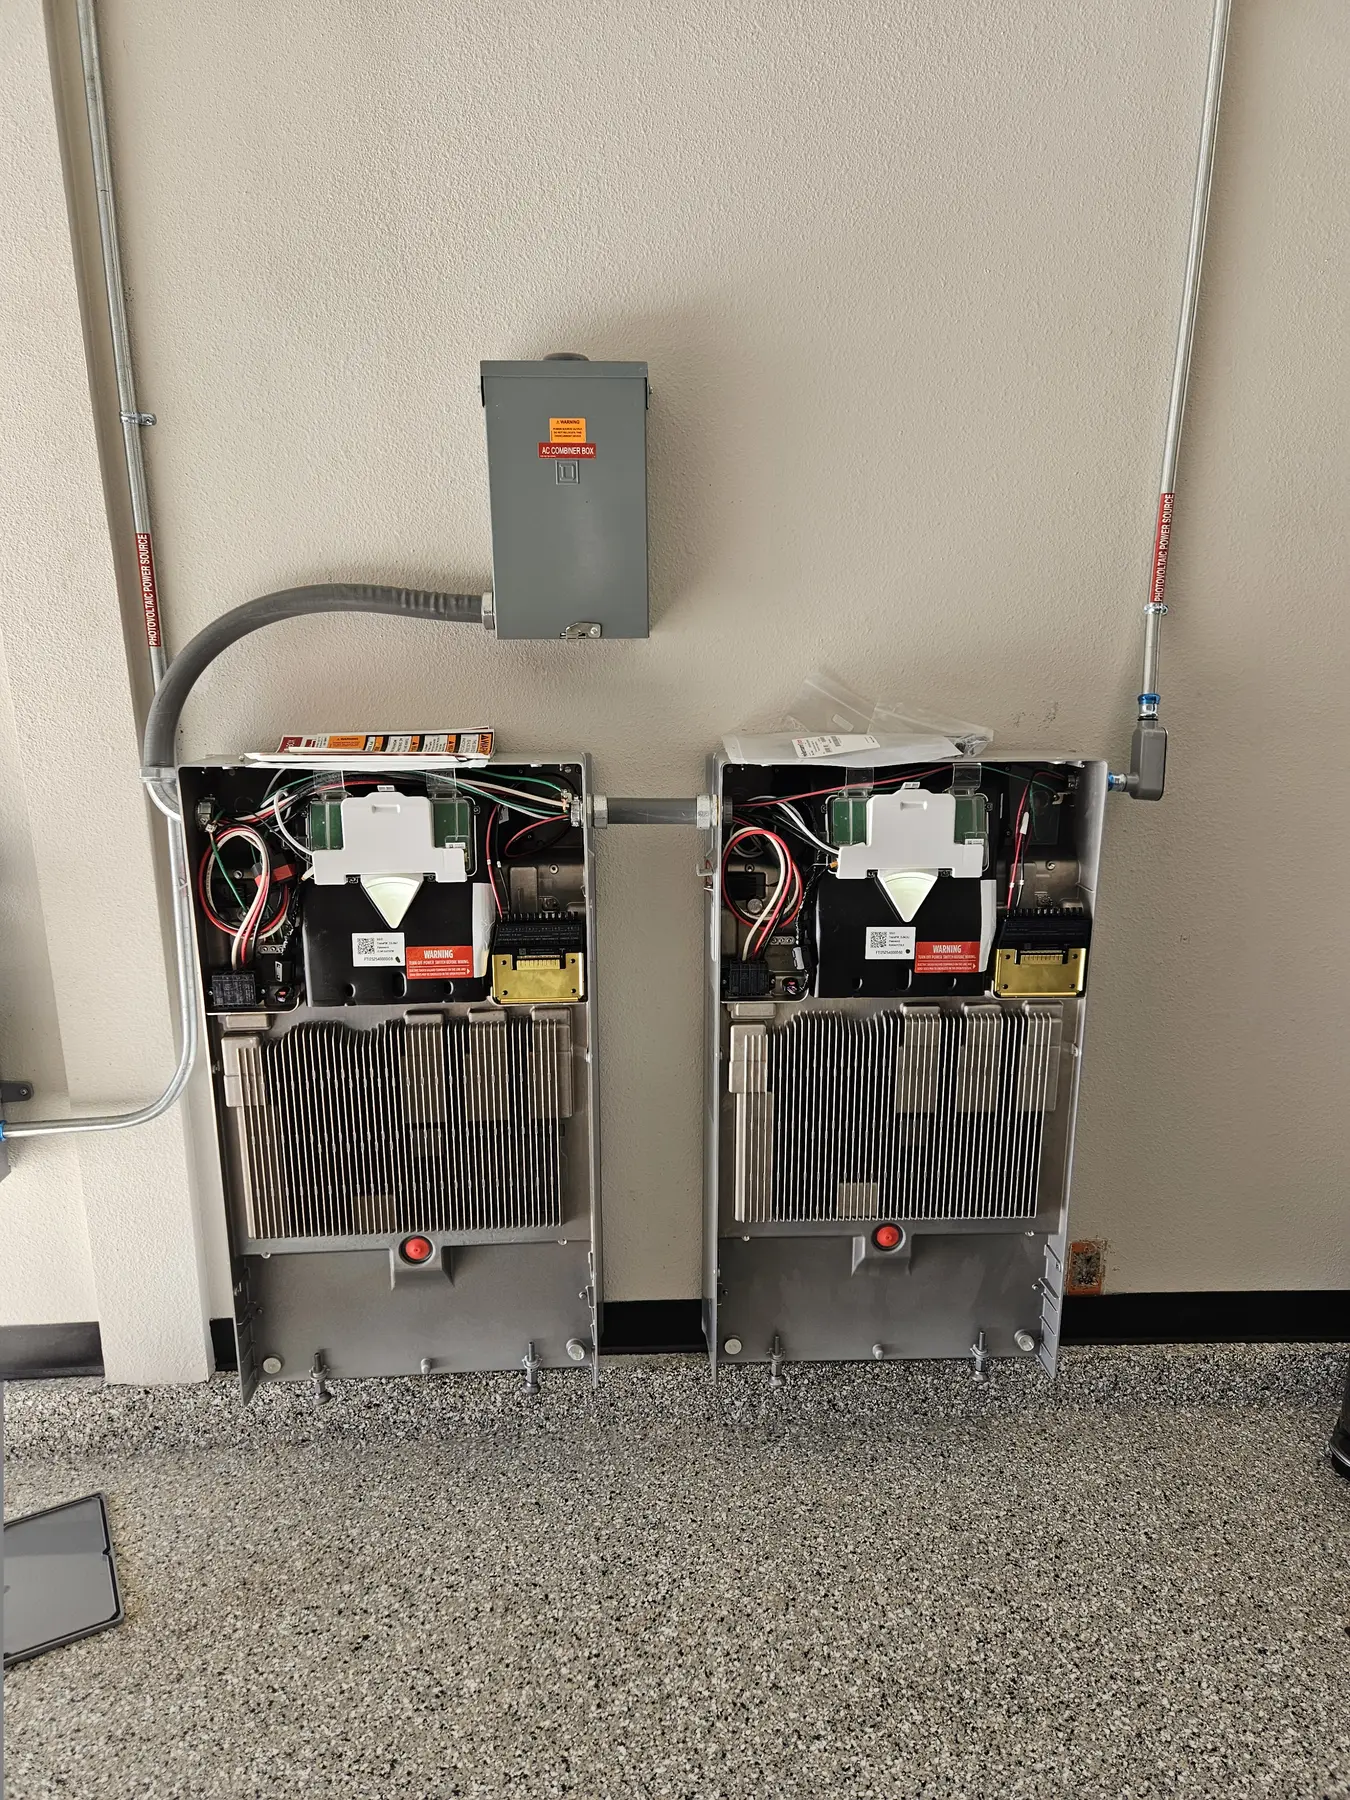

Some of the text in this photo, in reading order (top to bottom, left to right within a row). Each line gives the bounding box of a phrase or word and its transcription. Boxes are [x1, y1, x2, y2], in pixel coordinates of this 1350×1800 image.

[541, 446, 594, 455] AC COMBINER BOX
[1154, 494, 1174, 602] PHOTOVOLTAIC POWER SOURCE
[138, 534, 157, 646] PHOTOVOLTAIC POWER SOURCE
[424, 949, 454, 958] WARNING
[933, 945, 961, 953] WARNING
